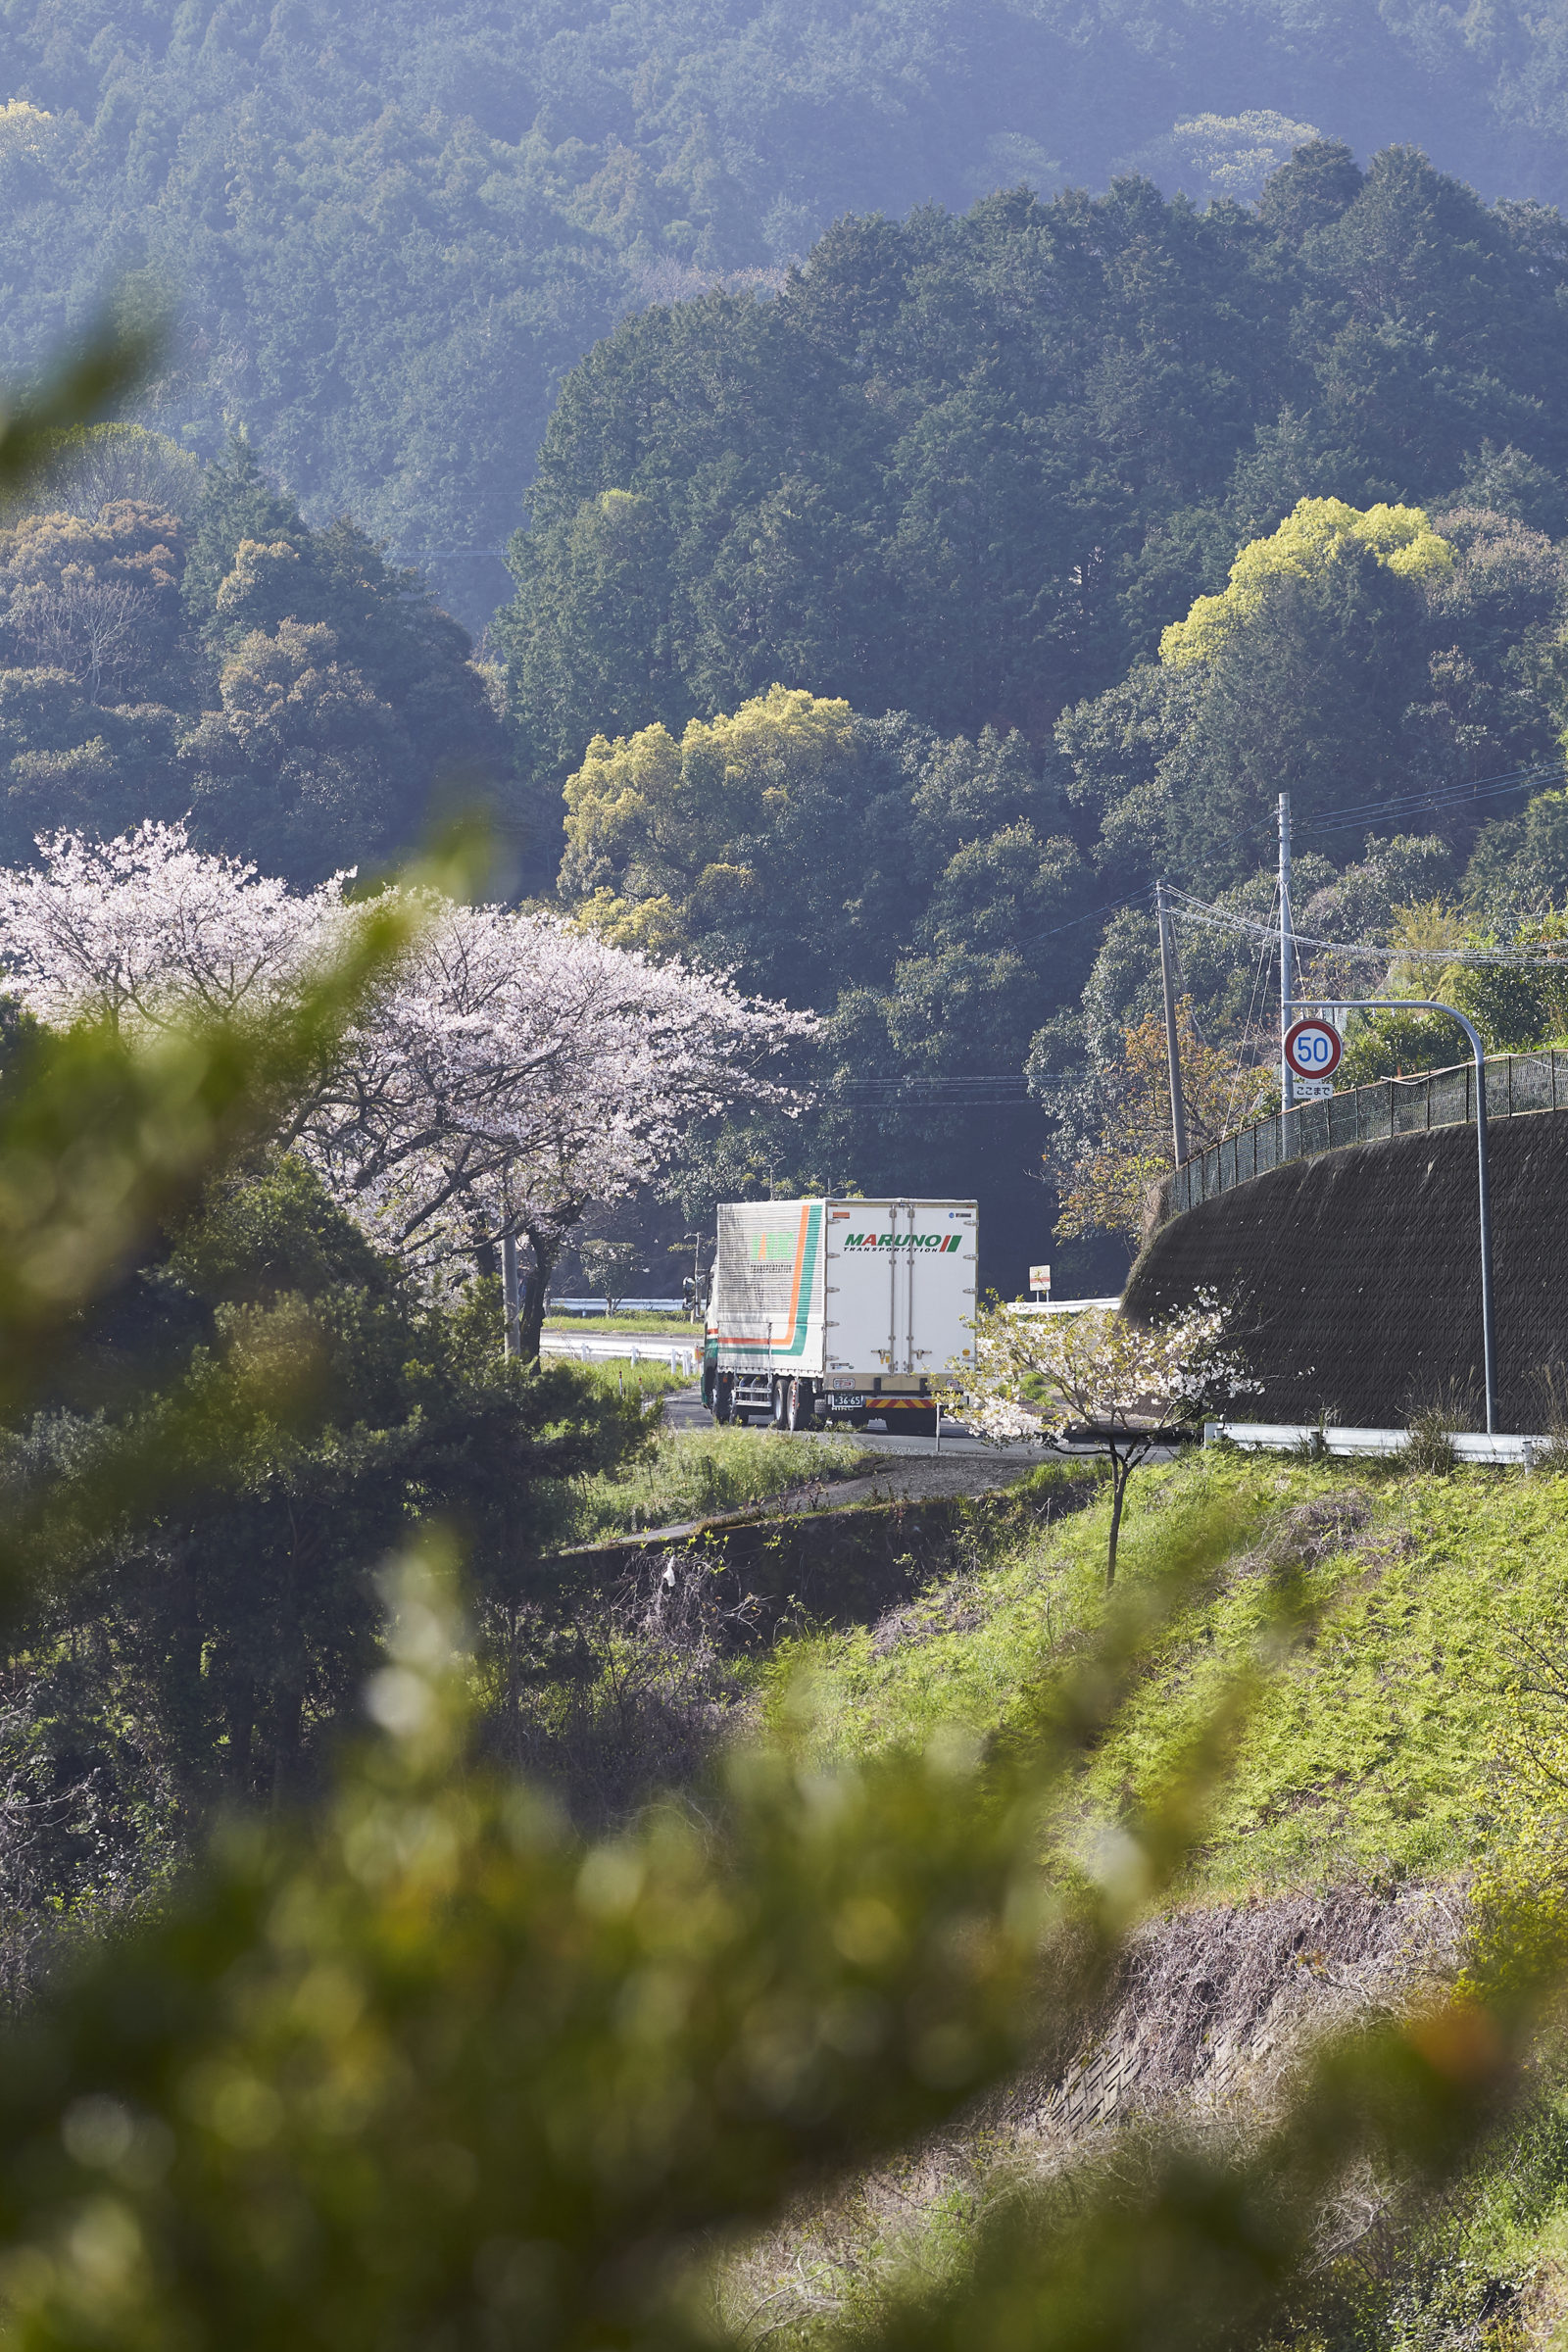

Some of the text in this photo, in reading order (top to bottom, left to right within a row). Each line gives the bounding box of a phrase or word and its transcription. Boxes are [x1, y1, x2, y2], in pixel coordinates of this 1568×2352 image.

[1298, 1037, 1328, 1062] 50
[1297, 1086, 1330, 1096] ここまで
[844, 1234, 942, 1247] MARUNO
